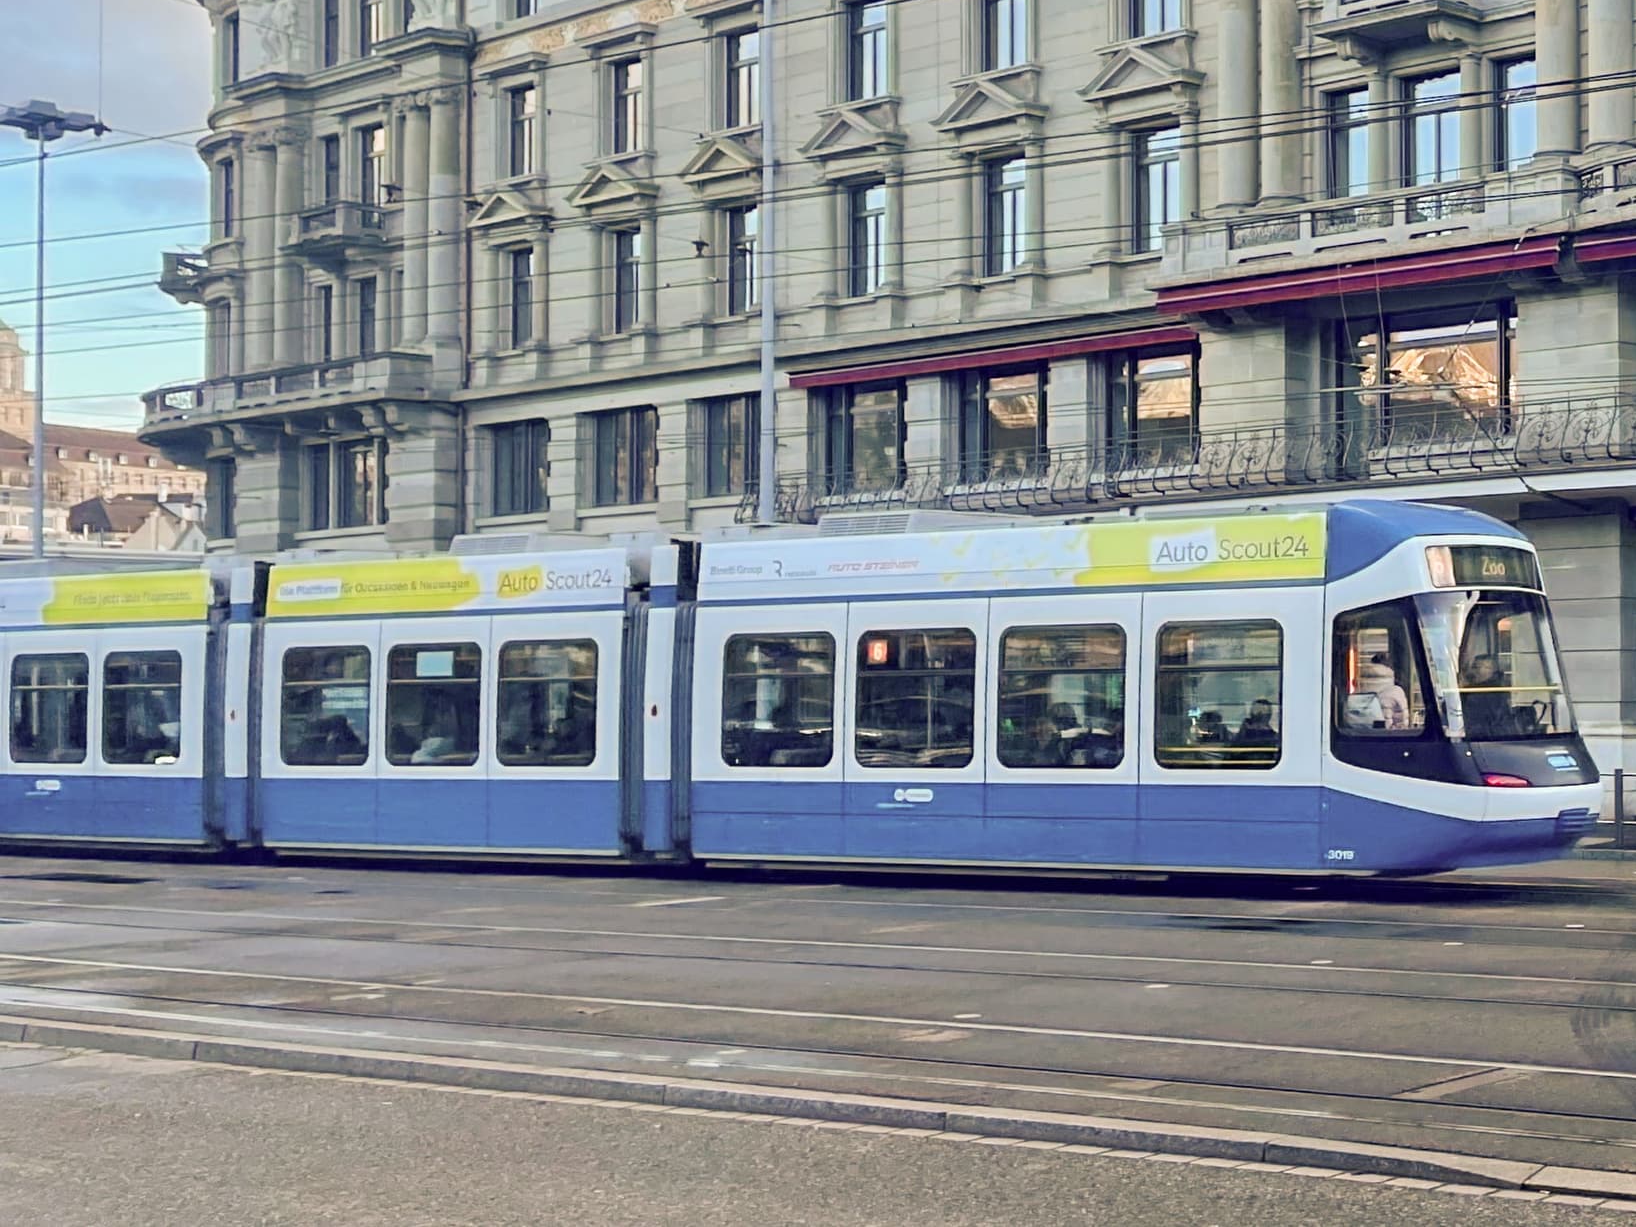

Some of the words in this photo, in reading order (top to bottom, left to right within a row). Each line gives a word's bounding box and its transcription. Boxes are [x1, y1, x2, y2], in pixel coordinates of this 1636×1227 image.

[1155, 540, 1209, 563] Auto
[1217, 535, 1309, 561] Scout24
[1481, 556, 1506, 576] Zoo
[499, 572, 539, 592] Auto
[545, 568, 612, 590] Scout24
